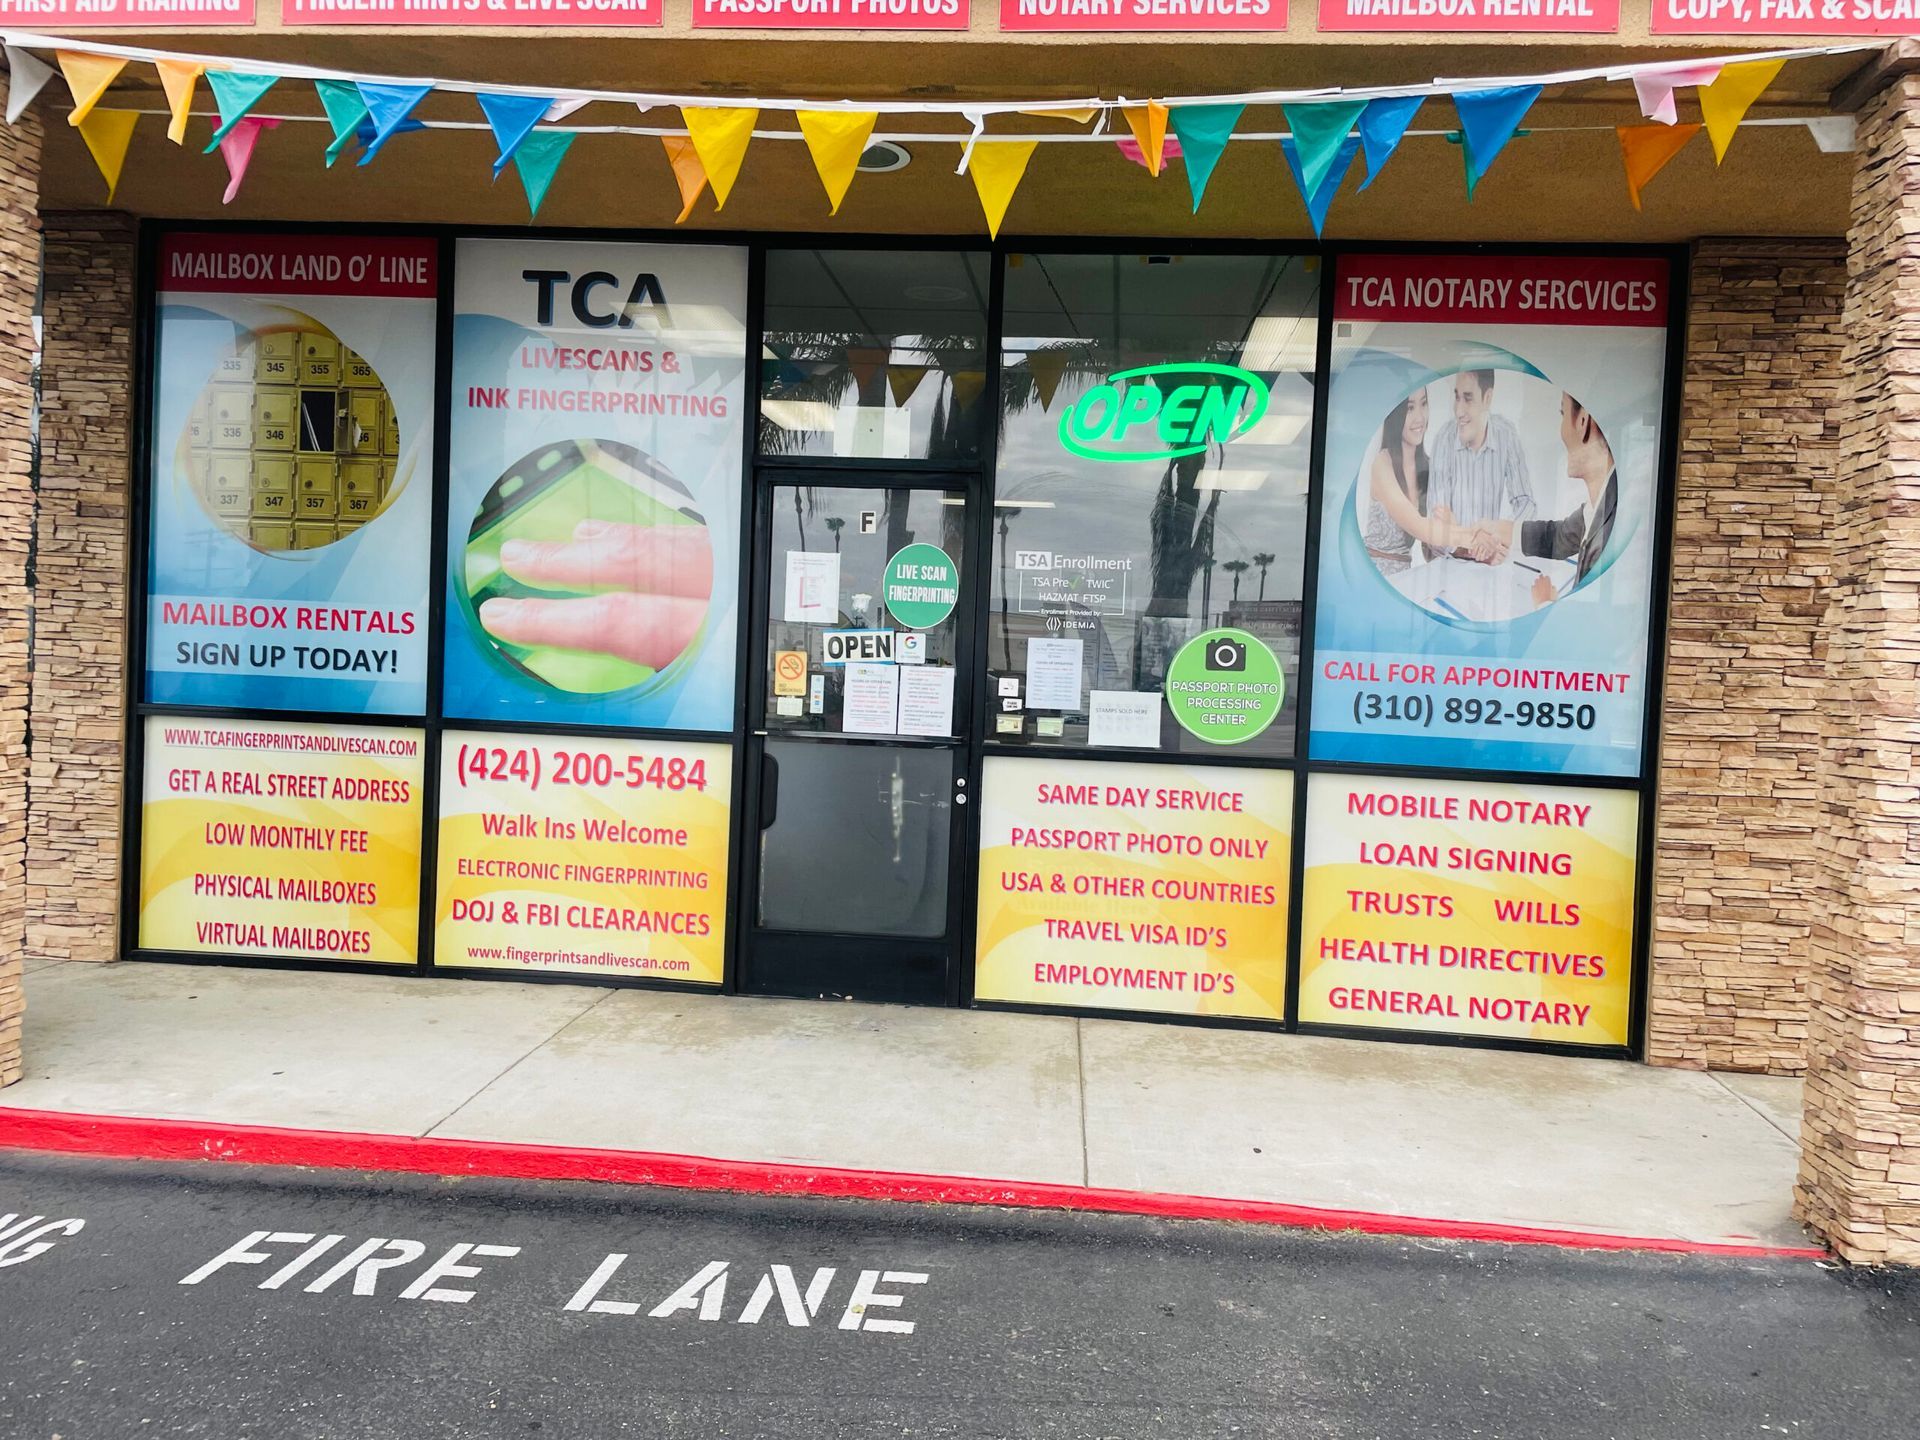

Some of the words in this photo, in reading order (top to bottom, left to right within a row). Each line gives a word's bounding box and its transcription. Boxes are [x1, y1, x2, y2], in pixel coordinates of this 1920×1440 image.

[1668, 0, 1752, 22] COPY,
[1760, 0, 1815, 19] FAX
[1821, 0, 1846, 19] &
[170, 253, 275, 281] MAILBOX
[280, 255, 342, 282] LAND
[379, 257, 429, 284] LINE
[523, 270, 671, 330] TCA
[1347, 276, 1396, 308] TCA
[1403, 277, 1512, 310] NOTARY
[1518, 279, 1657, 312] SERCVICES
[223, 360, 241, 370] 335
[267, 363, 284, 372] 345
[311, 365, 329, 374] 355
[353, 366, 371, 376] 365
[521, 347, 654, 374] LIVESCANS
[662, 351, 680, 374] &
[468, 386, 510, 409] INK
[518, 388, 728, 418] FINGERPRINTING
[1072, 385, 1247, 442] OPEN
[266, 430, 284, 440] 346
[220, 495, 238, 504] 337
[265, 497, 283, 507] 347
[306, 498, 324, 508] 357
[350, 500, 368, 509] 367
[861, 512, 875, 532] F
[897, 565, 918, 579] LIVE
[921, 565, 947, 581] SCAN
[1019, 554, 1048, 567] TSA
[1055, 555, 1132, 570] Enrollment
[889, 587, 955, 604] FINGERPRINTING
[1032, 577, 1050, 586] TSA
[1039, 592, 1078, 602] HAZMAT
[1083, 594, 1106, 603] FTSP
[163, 603, 287, 628] MAILBOX
[296, 607, 415, 635] RENTALS
[1063, 621, 1095, 629] IDEMIA
[177, 641, 239, 666] SIGN
[249, 644, 286, 668] UP
[293, 646, 397, 674] TODAY!
[828, 634, 891, 658] OPEN
[1172, 682, 1234, 693] PASSPORT
[1237, 683, 1278, 695] PHOTO
[1325, 661, 1379, 682] CALL
[1388, 663, 1435, 684] FOR
[1443, 666, 1629, 693] APPOINTMENT
[1188, 698, 1261, 709] PROCESSING
[1353, 691, 1433, 727] (310)
[1444, 697, 1596, 730] 892-9850
[1201, 714, 1247, 725] CENTER
[164, 729, 417, 756] WWW.TCAFINGERPRINTSANDLIVESCAN.COM
[457, 743, 541, 790] (424)
[552, 751, 707, 791] 200-5484
[168, 769, 200, 791] GET
[205, 771, 216, 790] A
[221, 771, 262, 796] REAL
[267, 773, 328, 798] STREET
[331, 777, 410, 803] ADDRESS
[1038, 783, 1099, 805] SAME
[1105, 786, 1149, 807] DAY
[1156, 788, 1243, 813] SERVICE
[1348, 792, 1457, 820] MOBILE
[1468, 799, 1590, 827] NOTARY
[205, 822, 245, 846] LOW
[249, 824, 335, 850] MONTHLY
[339, 829, 368, 853] FEE
[482, 813, 537, 837] Walk
[545, 817, 576, 840] Ins
[583, 819, 688, 847] Welcome
[1011, 827, 1120, 850] PASSPORT
[1127, 832, 1203, 856] PHOTO
[1209, 837, 1268, 859] ONLY
[1359, 841, 1438, 868] LOAN
[1447, 847, 1572, 876] SIGNING
[458, 858, 558, 881] ELECTRONIC
[564, 865, 708, 889] FINGERPRINTING
[1001, 871, 1044, 892] USA
[1050, 873, 1066, 893] &
[1073, 875, 1145, 897] OTHER
[1151, 879, 1276, 905] COUNTRIES
[194, 872, 273, 899] PHYSICAL
[278, 878, 377, 906] MAILBOXES
[452, 898, 494, 923] DOJ
[501, 901, 519, 924] &
[526, 903, 559, 926] FBI
[566, 905, 710, 936] CLEARANCES
[1347, 890, 1454, 918] TRUSTS
[1494, 899, 1581, 927] WILLS
[196, 922, 268, 947] VIRTUAL
[272, 926, 371, 954] MAILBOXES
[1045, 918, 1123, 942] TRAVEL
[1130, 923, 1179, 945] VISA
[469, 947, 689, 970] www.fingerprintsandlivescan.com
[1319, 937, 1429, 966] HEALTH
[1439, 945, 1605, 978] DIRECTIVES
[1034, 962, 1187, 990] EMPLOYMENT
[1328, 986, 1458, 1017] GENERAL
[1468, 996, 1590, 1026] NOTARY
[178, 1230, 522, 1304] FIRE
[562, 1253, 929, 1334] LANE
